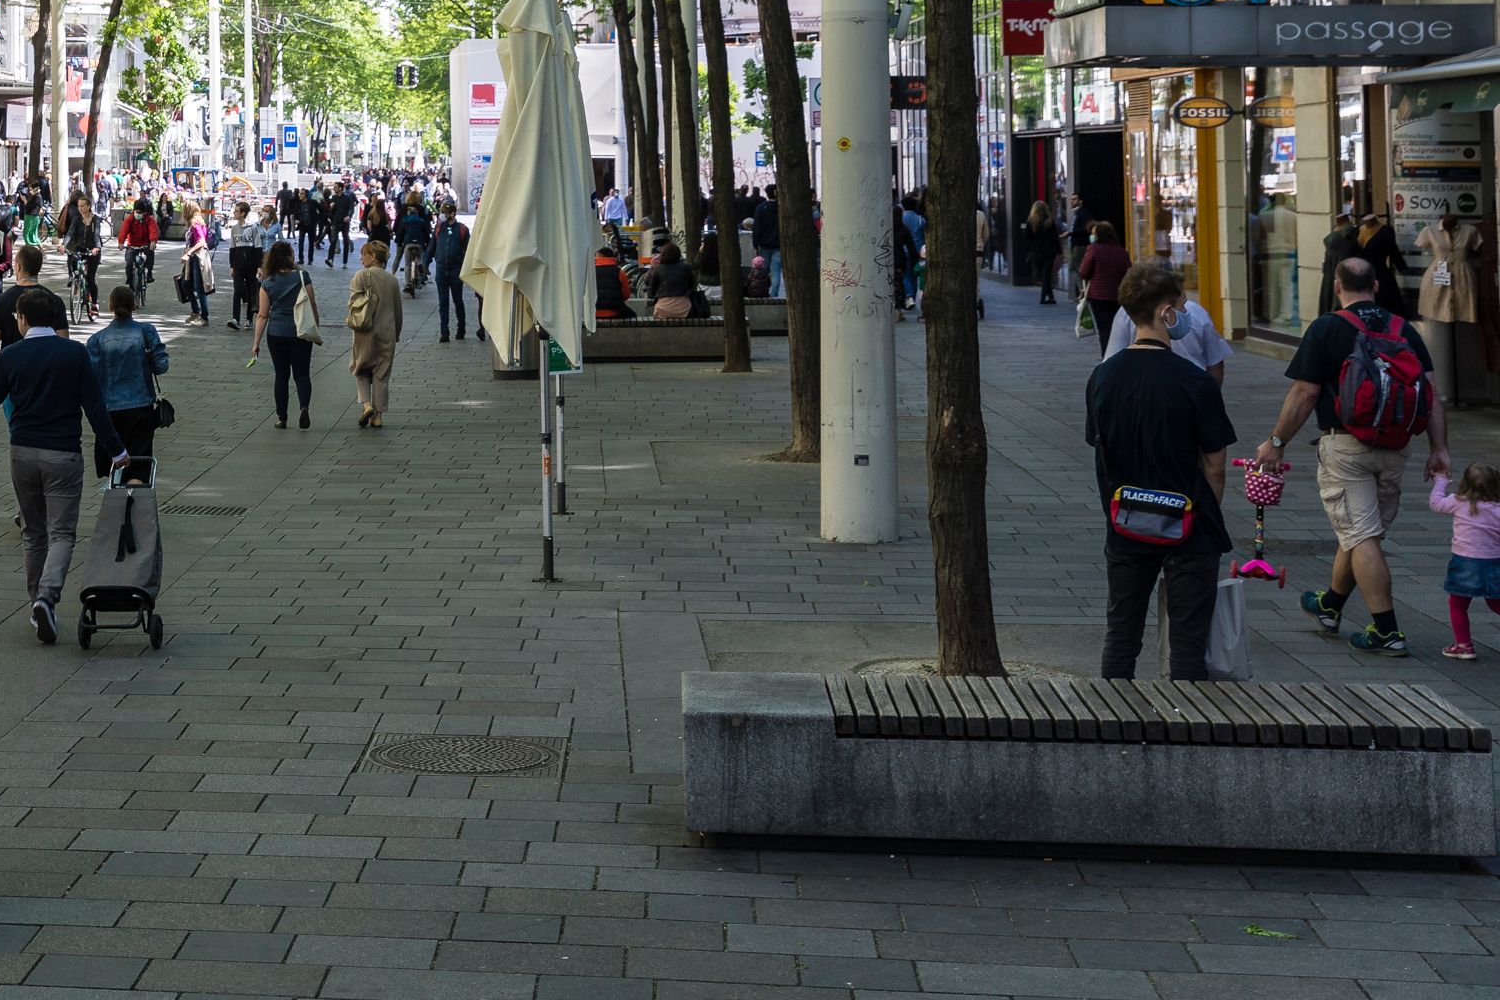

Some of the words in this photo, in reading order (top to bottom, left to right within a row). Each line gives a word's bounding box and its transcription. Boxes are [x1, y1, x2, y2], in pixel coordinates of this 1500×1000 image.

[1276, 21, 1453, 46] passage
[1180, 107, 1230, 118] FOSSIL
[1123, 490, 1186, 508] PLACES+FACES
